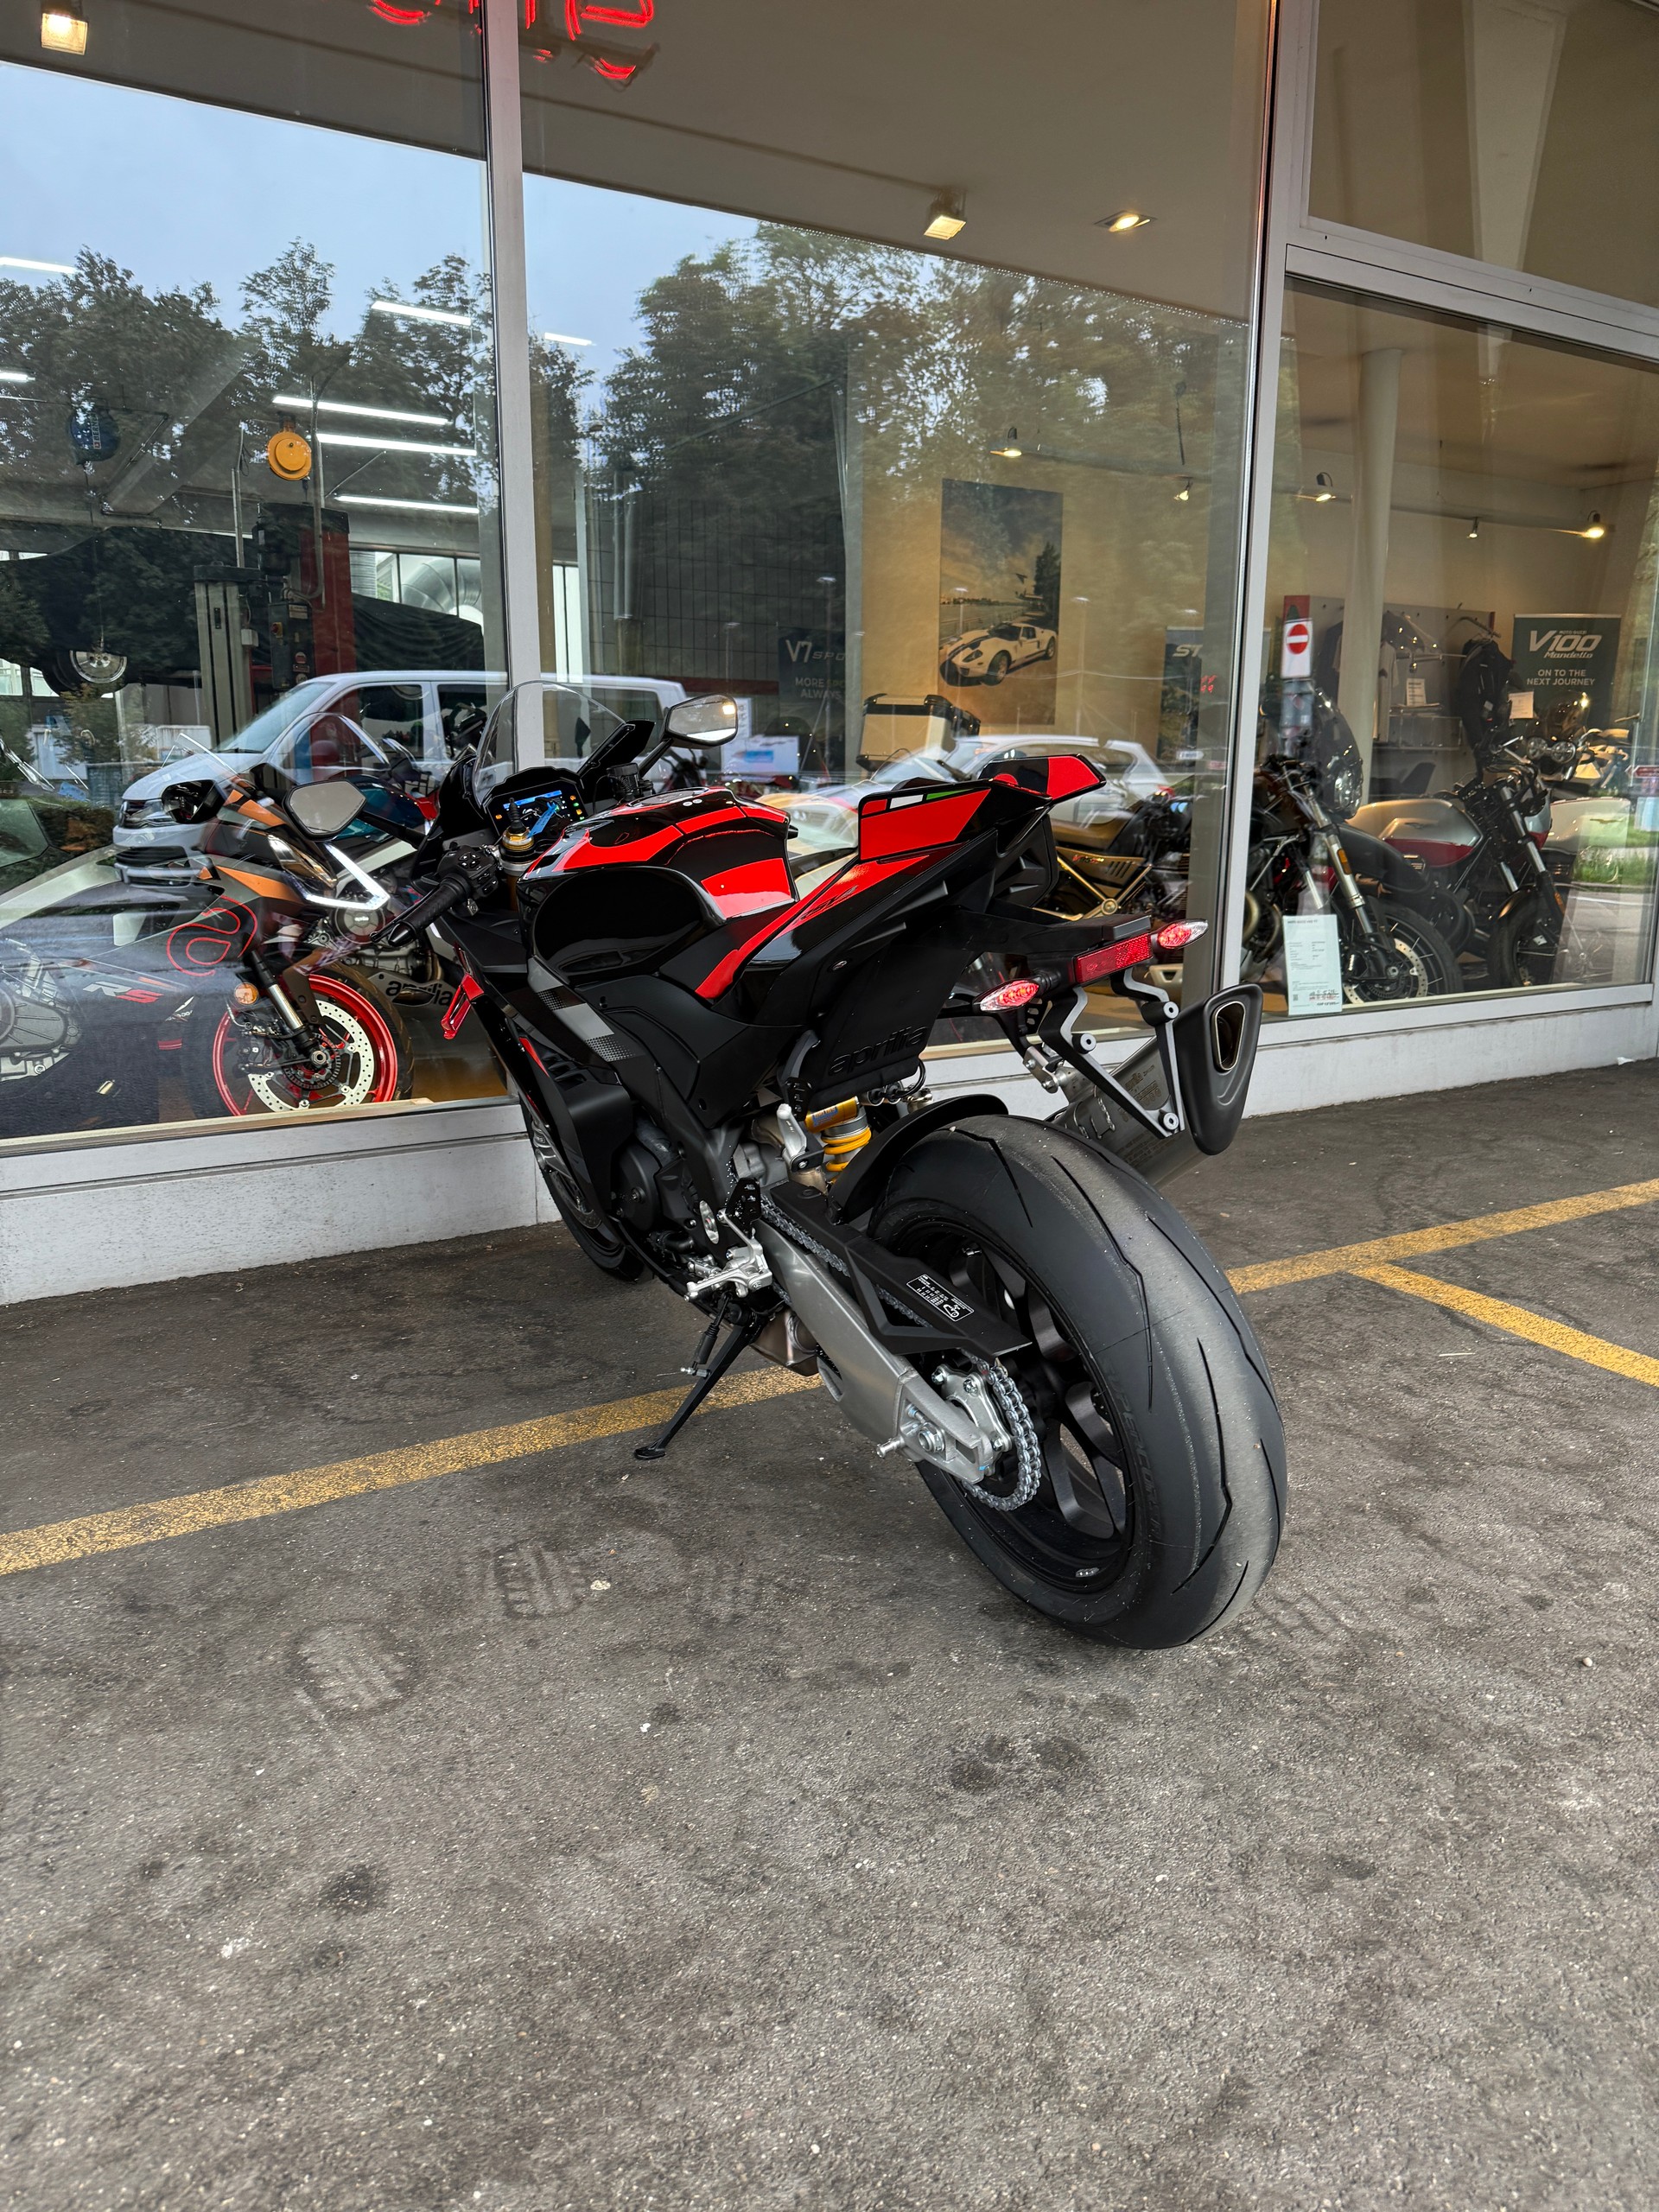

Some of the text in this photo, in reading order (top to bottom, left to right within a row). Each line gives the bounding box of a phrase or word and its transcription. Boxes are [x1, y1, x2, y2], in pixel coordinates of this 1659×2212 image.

[785, 639, 811, 663] V7
[1529, 630, 1603, 652] V100
[83, 982, 164, 1003] RS
[828, 1026, 928, 1077] aprilia
